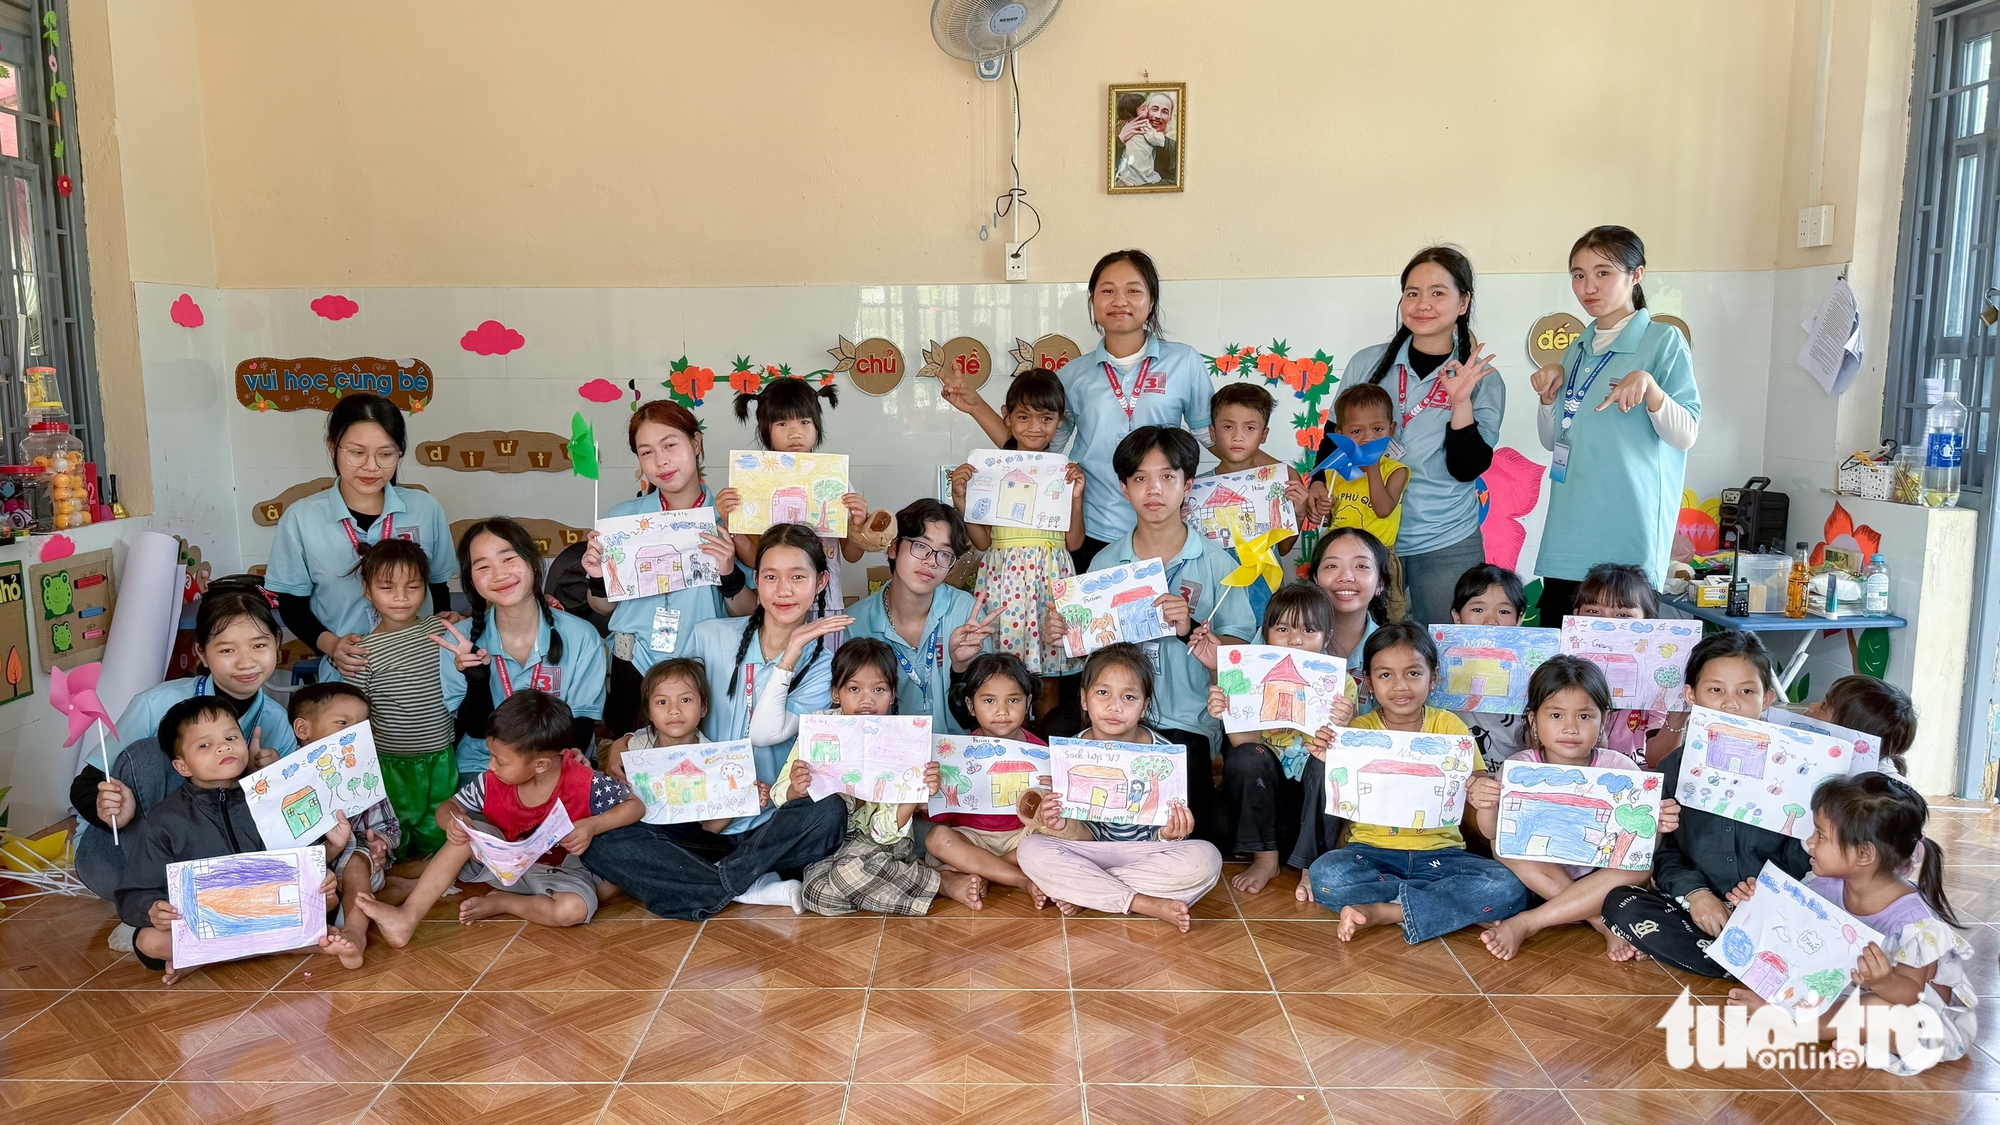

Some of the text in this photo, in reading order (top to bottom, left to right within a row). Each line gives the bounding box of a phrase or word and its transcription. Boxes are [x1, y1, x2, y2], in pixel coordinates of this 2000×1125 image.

[855, 348, 897, 374] chủ
[243, 364, 429, 397] vui học cùng bé
